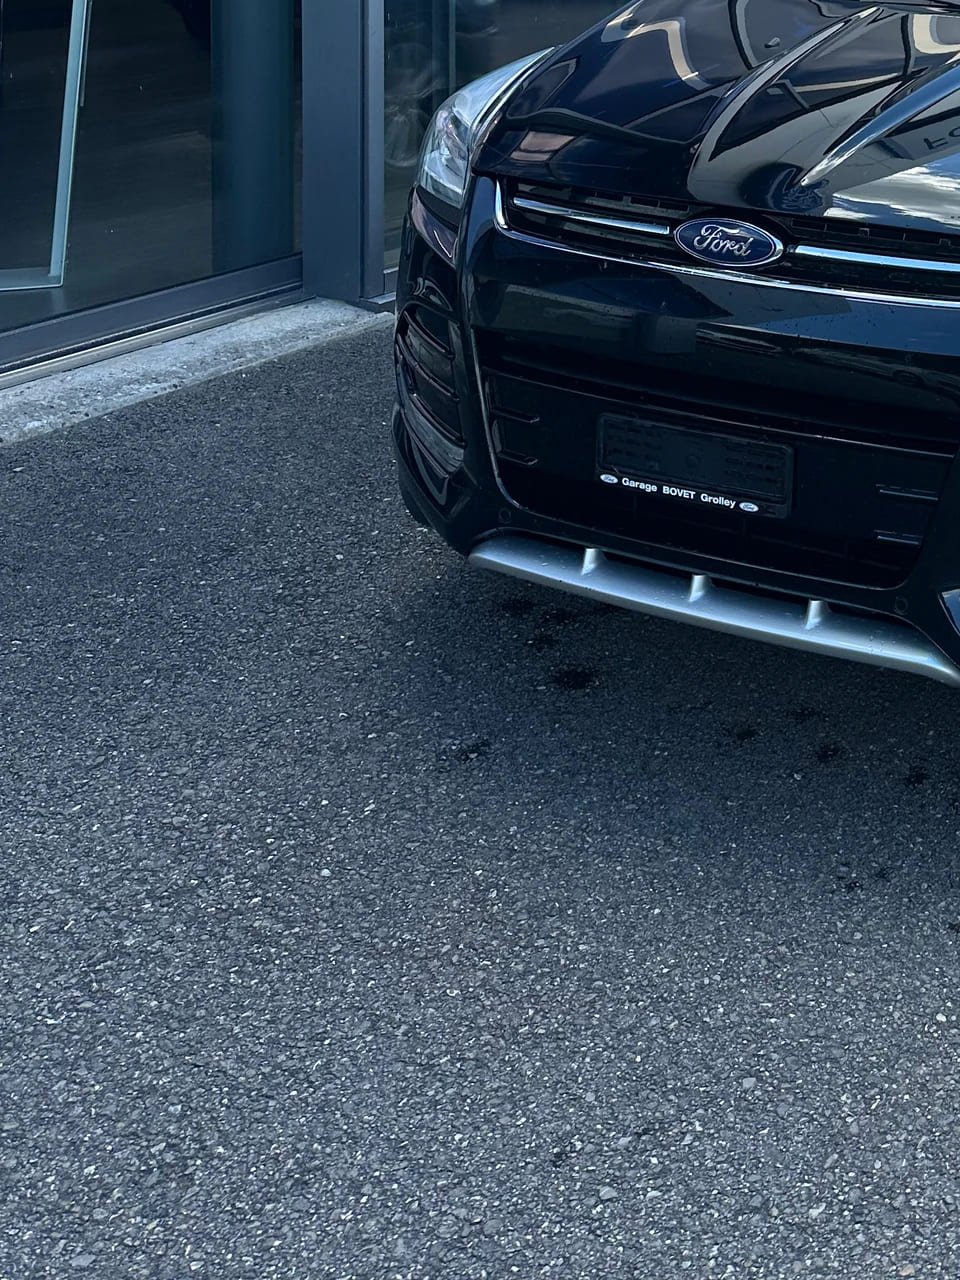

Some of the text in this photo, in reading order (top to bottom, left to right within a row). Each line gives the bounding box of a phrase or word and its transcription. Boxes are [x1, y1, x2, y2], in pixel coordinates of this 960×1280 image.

[694, 224, 754, 256] Ford
[622, 477, 657, 492] Garage
[662, 485, 696, 499] BOVET
[700, 493, 736, 509] Grolley
